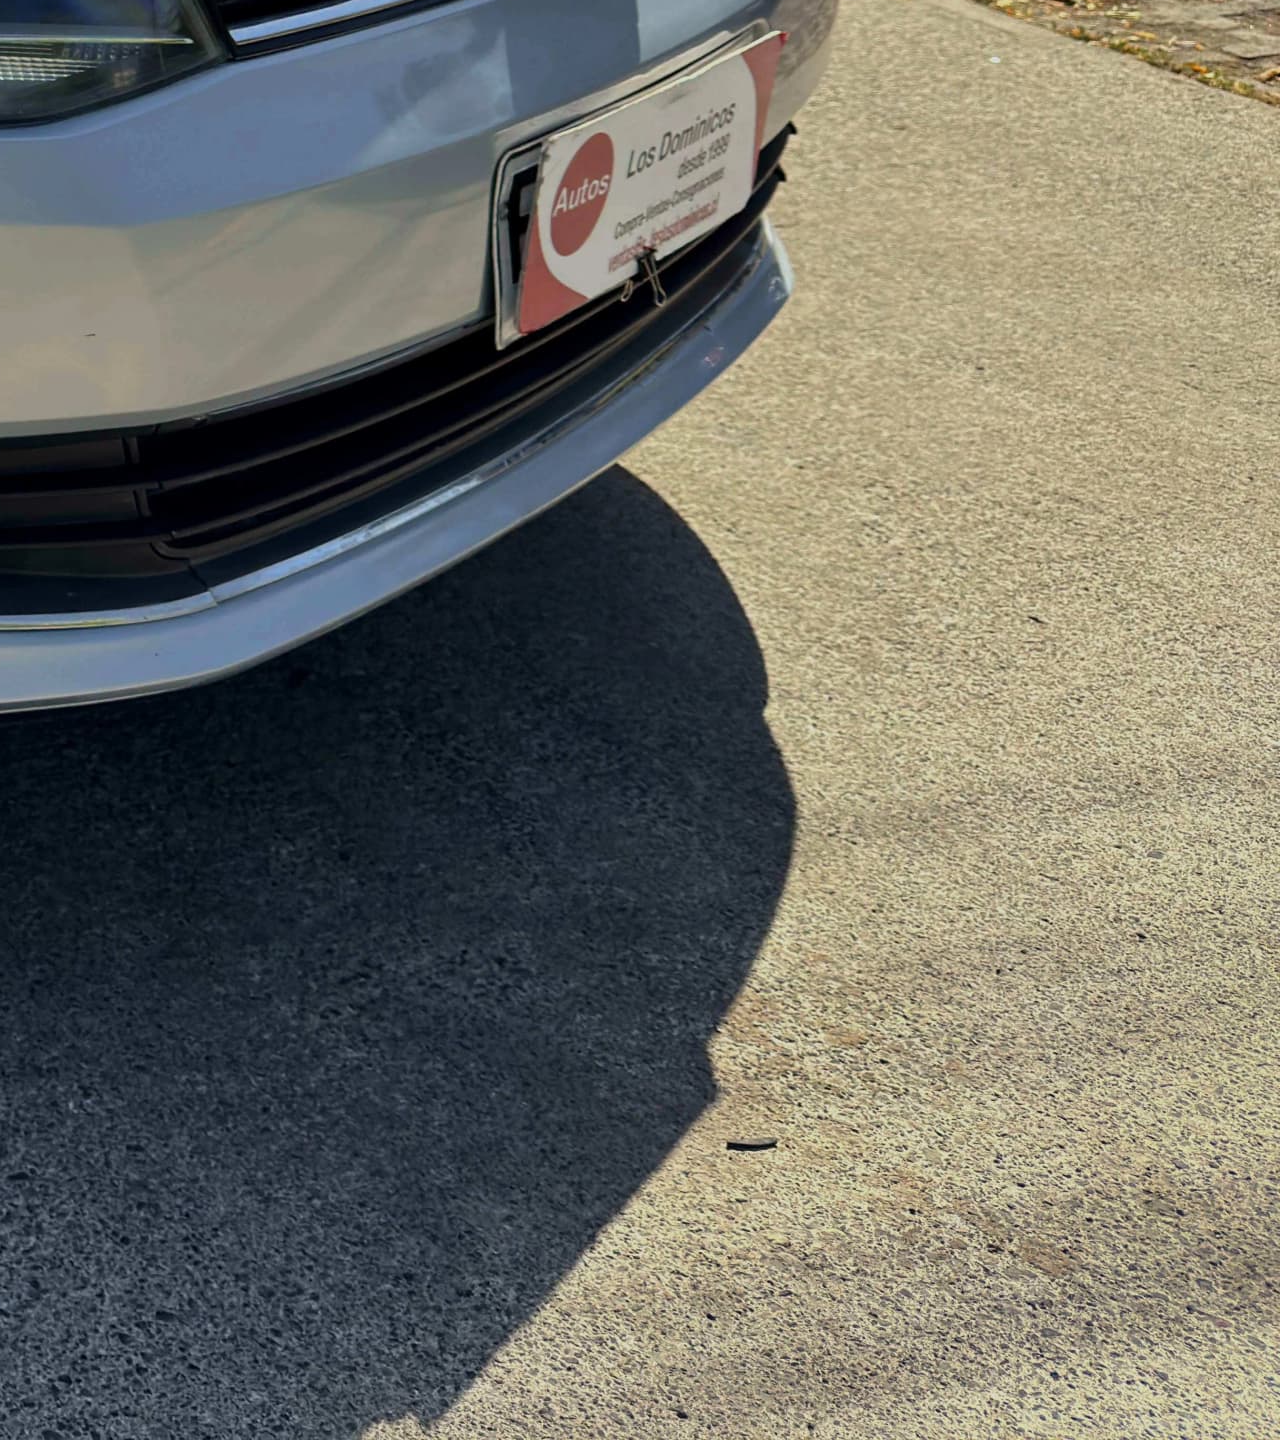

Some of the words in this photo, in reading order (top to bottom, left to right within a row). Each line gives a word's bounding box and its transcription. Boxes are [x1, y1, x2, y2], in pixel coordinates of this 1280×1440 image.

[551, 173, 611, 218] Autos
[626, 145, 657, 179] Los
[659, 102, 737, 162] Dominicos
